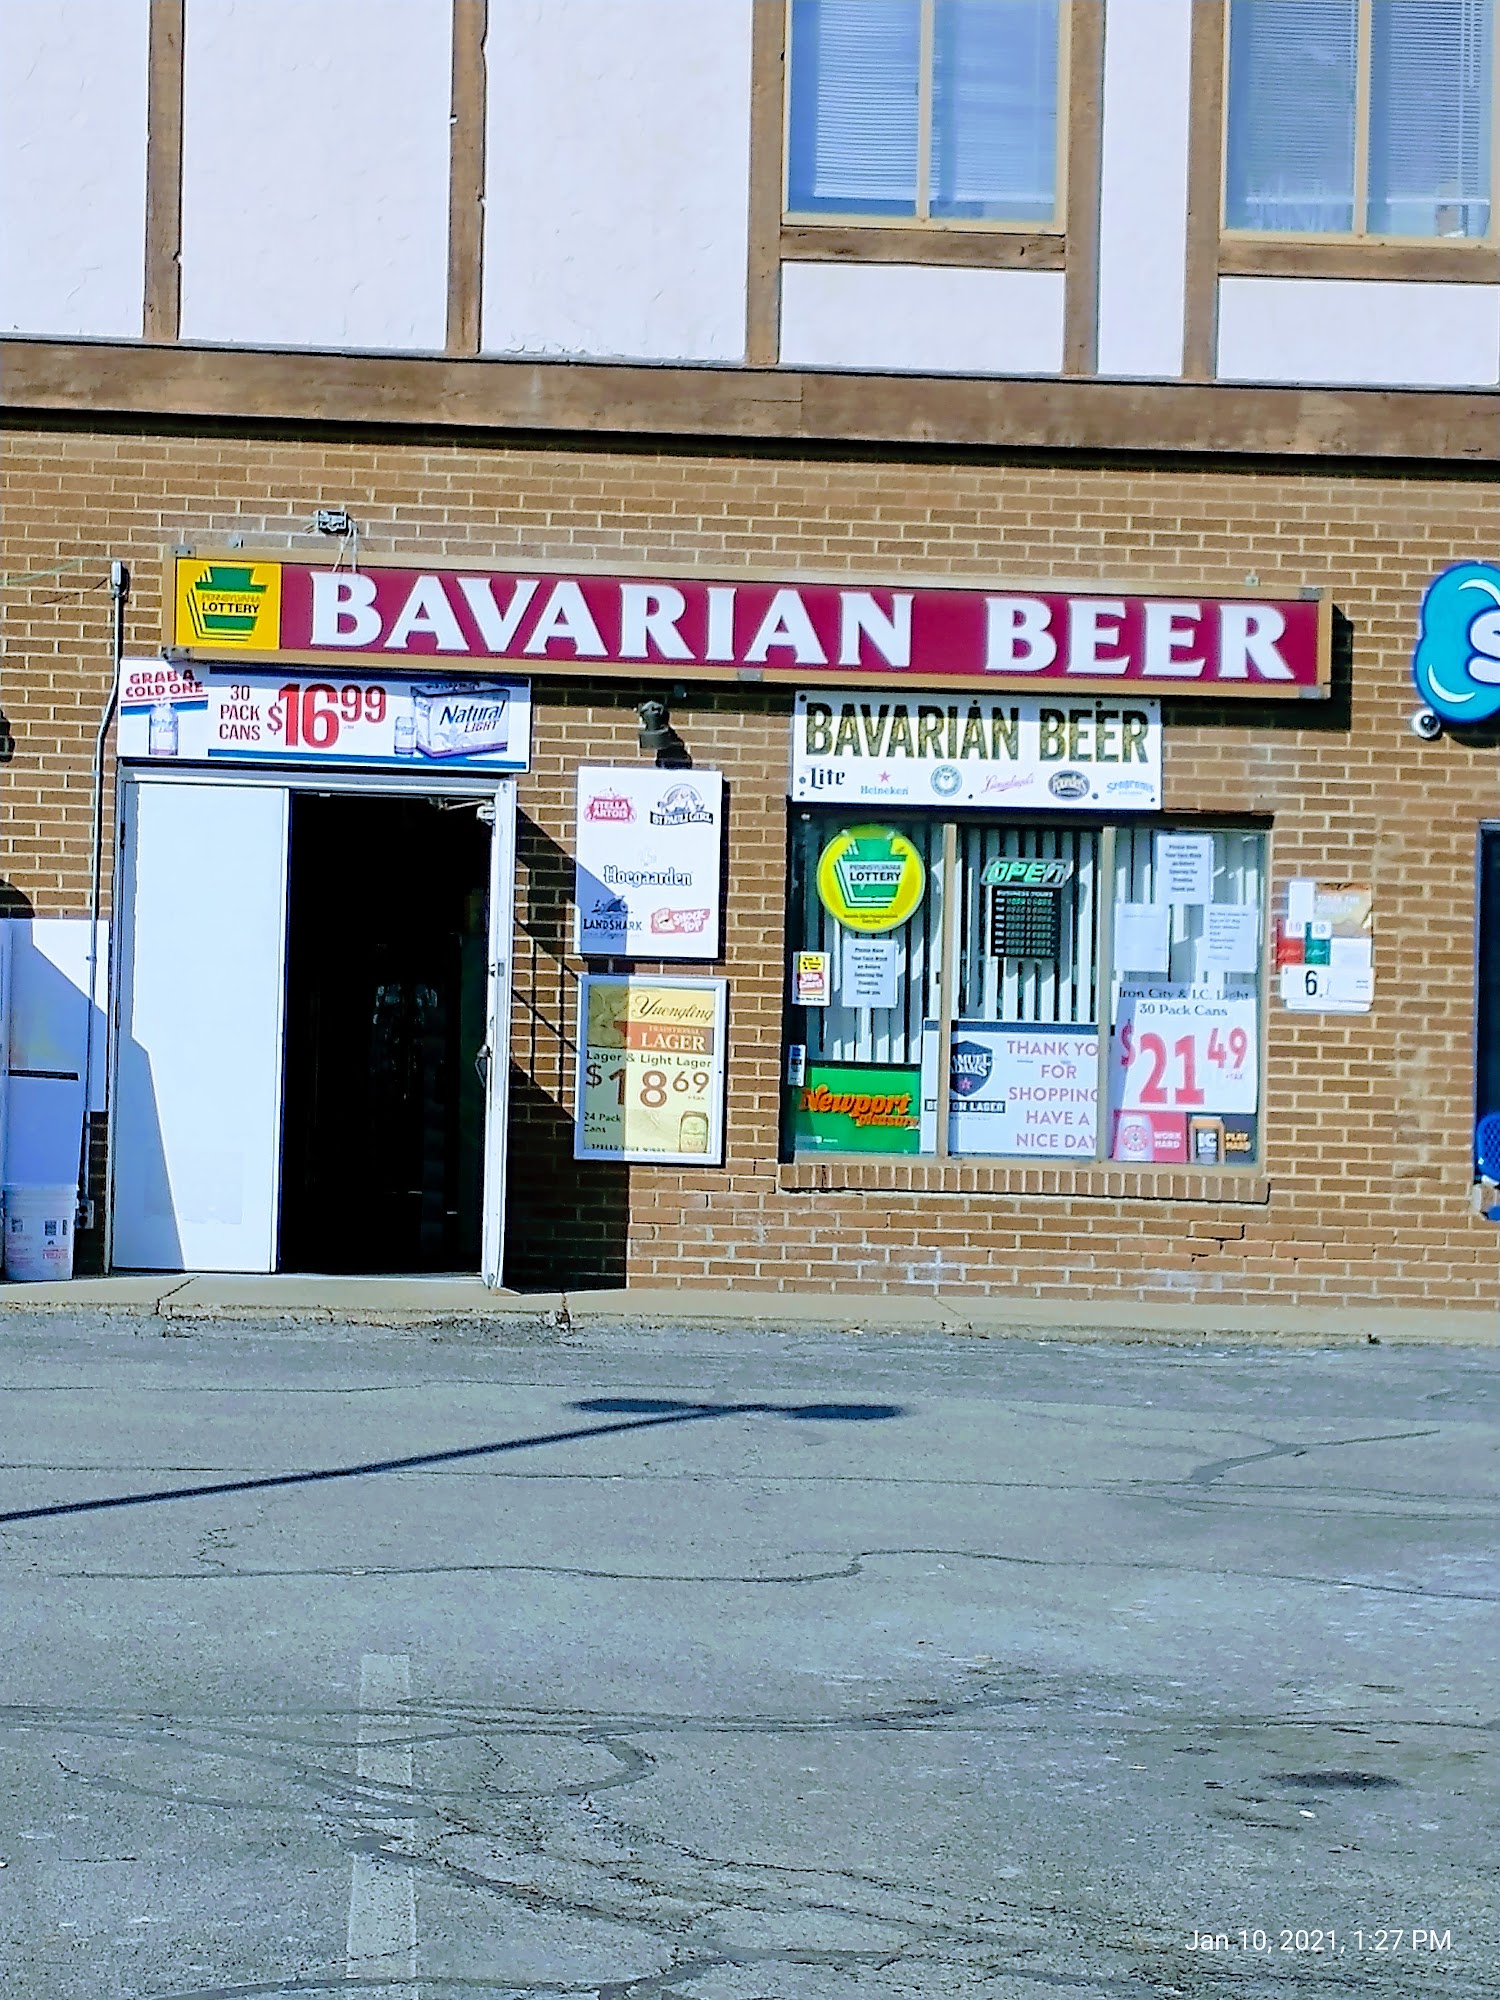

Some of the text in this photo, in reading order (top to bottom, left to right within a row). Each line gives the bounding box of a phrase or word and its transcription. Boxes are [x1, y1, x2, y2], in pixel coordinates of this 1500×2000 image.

[201, 602, 260, 613] LOTTERY
[311, 572, 1294, 680] BAVARIAN BEER
[129, 669, 195, 684] GRAB A
[125, 681, 203, 697] COLD ONE
[229, 685, 251, 700] 30
[219, 704, 261, 721] PACK
[439, 700, 506, 725] Natural
[219, 723, 261, 741] CANS
[464, 720, 500, 732] LIGHT
[805, 701, 1149, 764] BAVARIAN BEER
[811, 767, 846, 790] Lite
[860, 785, 909, 796] Heineken
[593, 801, 628, 810] STELLA
[592, 809, 628, 818] ARTOIS
[603, 864, 693, 887] Hoegaarden
[849, 872, 901, 881] LOTTERY
[986, 860, 1064, 883] OPEN
[583, 918, 643, 931] LANDSHARK
[672, 910, 706, 926] SHOCK
[680, 919, 702, 933] TOP
[1119, 986, 1145, 998] Iron
[1149, 987, 1174, 1000] City
[1178, 989, 1187, 999] &
[631, 994, 714, 1023] Yuengling
[1139, 1004, 1228, 1016] 30 Pack Cans
[641, 1032, 705, 1052] LAGER
[1006, 1040, 1098, 1057] THANK YO
[586, 1049, 712, 1069] Lager & Light Lager
[951, 1053, 992, 1068] AMUEL
[1041, 1064, 1077, 1079] FOR
[799, 1083, 912, 1118] Newport
[969, 1101, 1005, 1112] LAGER
[599, 1112, 621, 1123] Pack
[1026, 1110, 1090, 1126] HAVE A
[1016, 1133, 1096, 1149] NICE DAY
[1153, 1131, 1181, 1140] WORK
[1225, 1132, 1249, 1141] PLAY
[1153, 1140, 1181, 1149] HARD
